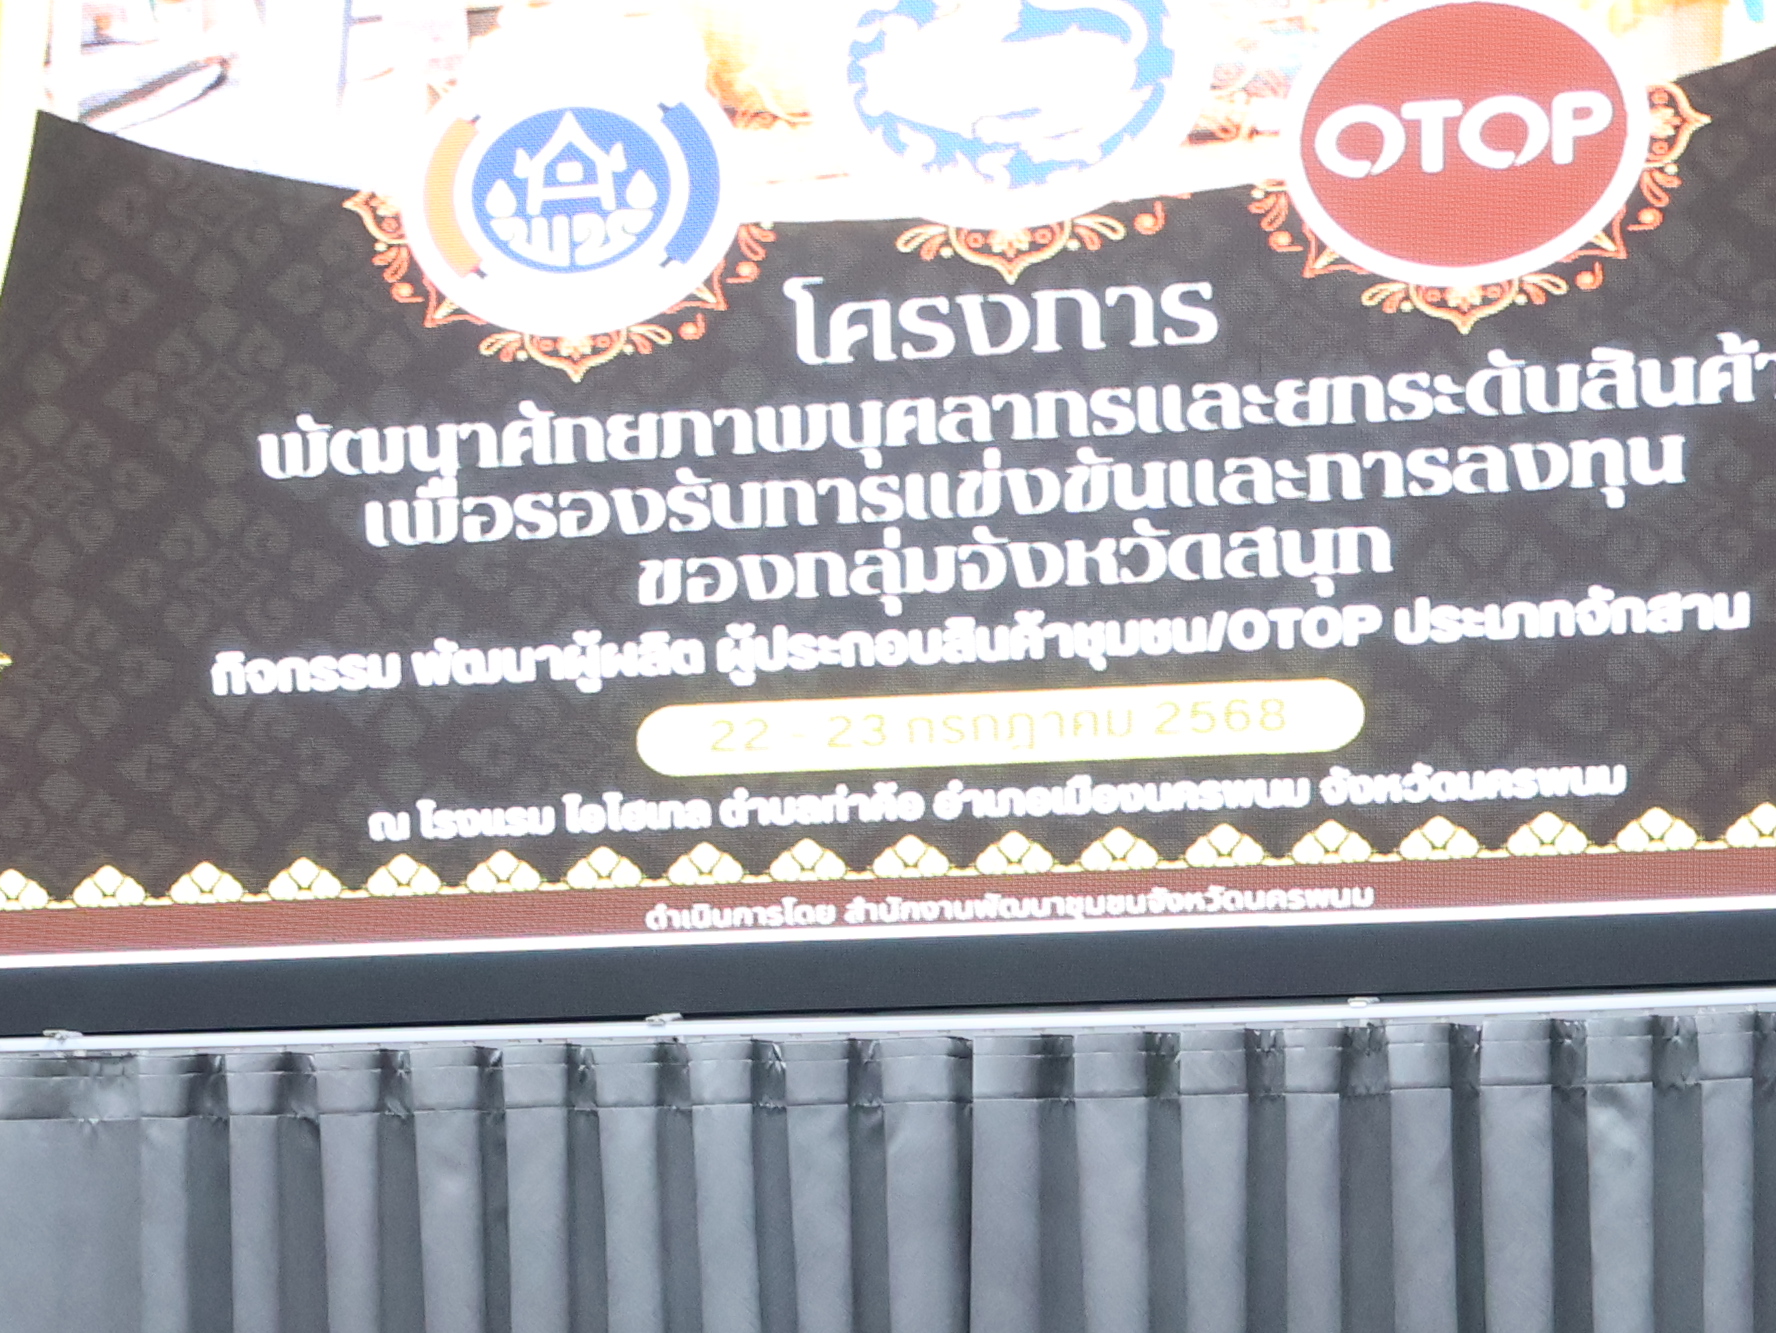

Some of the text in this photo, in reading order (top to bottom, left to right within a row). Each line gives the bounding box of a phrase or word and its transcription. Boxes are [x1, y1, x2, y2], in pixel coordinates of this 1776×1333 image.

[1314, 89, 1614, 179] OTOP
[782, 276, 1219, 365] โครงการ
[364, 433, 1687, 547] เพื่อรองรับการแข่งขันและการลงทุน
[637, 517, 1394, 617] ของกลุ่มจังหวัดสนุก
[210, 650, 402, 696] กิจกรรม
[411, 629, 707, 694] พัฒนาผู้ผลิต
[1393, 584, 1751, 646] ประเภทจักสาน
[709, 717, 771, 753] 22
[826, 713, 888, 749] 23
[906, 703, 1134, 750] กรกฎาคม
[1153, 697, 1287, 736] 2568
[367, 810, 411, 843] ณ
[415, 798, 557, 841] โรงแรม
[1319, 761, 1628, 807] จังหวัดนครพนม
